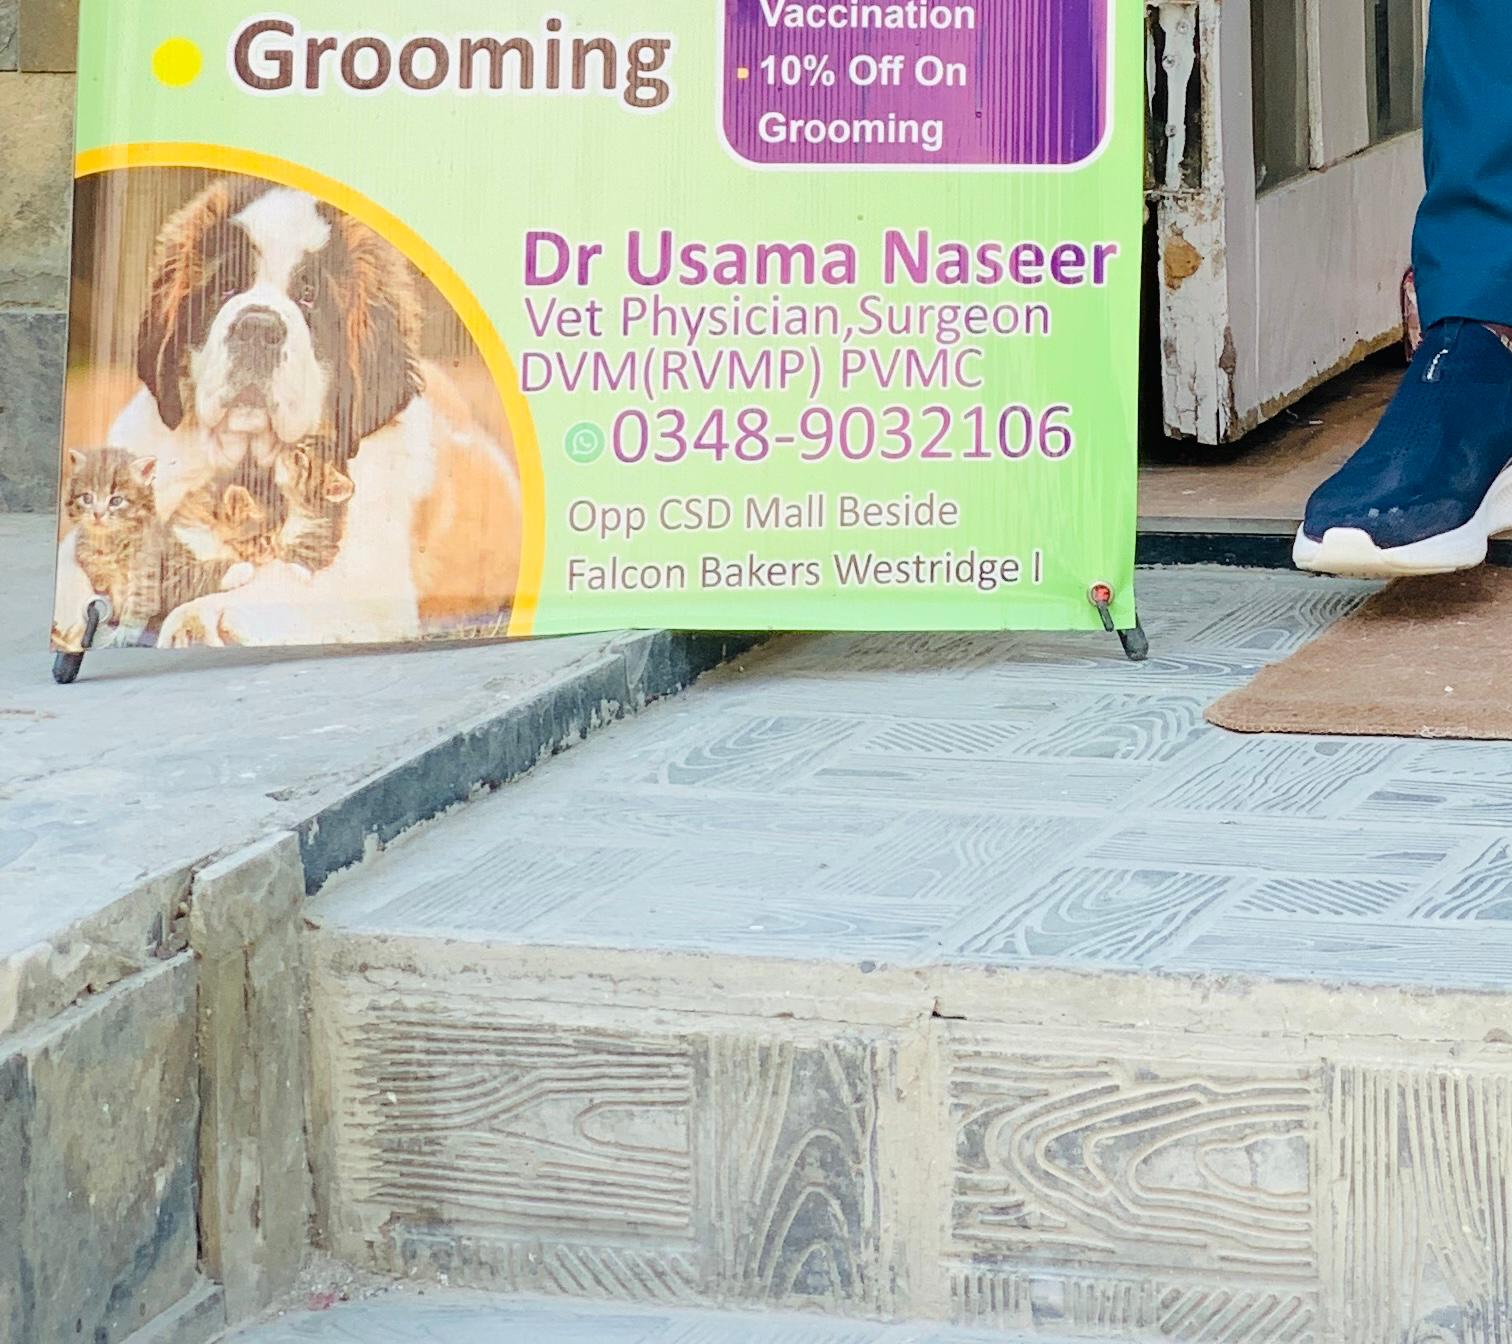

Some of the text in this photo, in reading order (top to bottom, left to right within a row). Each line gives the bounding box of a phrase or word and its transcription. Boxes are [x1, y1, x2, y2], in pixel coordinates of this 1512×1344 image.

[234, 18, 671, 108] Grooming
[761, 55, 966, 87] 10% Off On
[758, 112, 943, 152] Grooming
[524, 229, 1117, 286] Dr Usama Naseer
[524, 293, 1050, 345] Vet Physician,Surgeon
[521, 346, 984, 400] DVM(RVMP) PVMC
[612, 405, 1073, 464] 0348-9032106
[567, 493, 958, 540] Opp CSD Mall Beside
[567, 553, 685, 591] Falcon
[701, 553, 820, 590] Bakers
[834, 550, 1019, 591] Westridge
